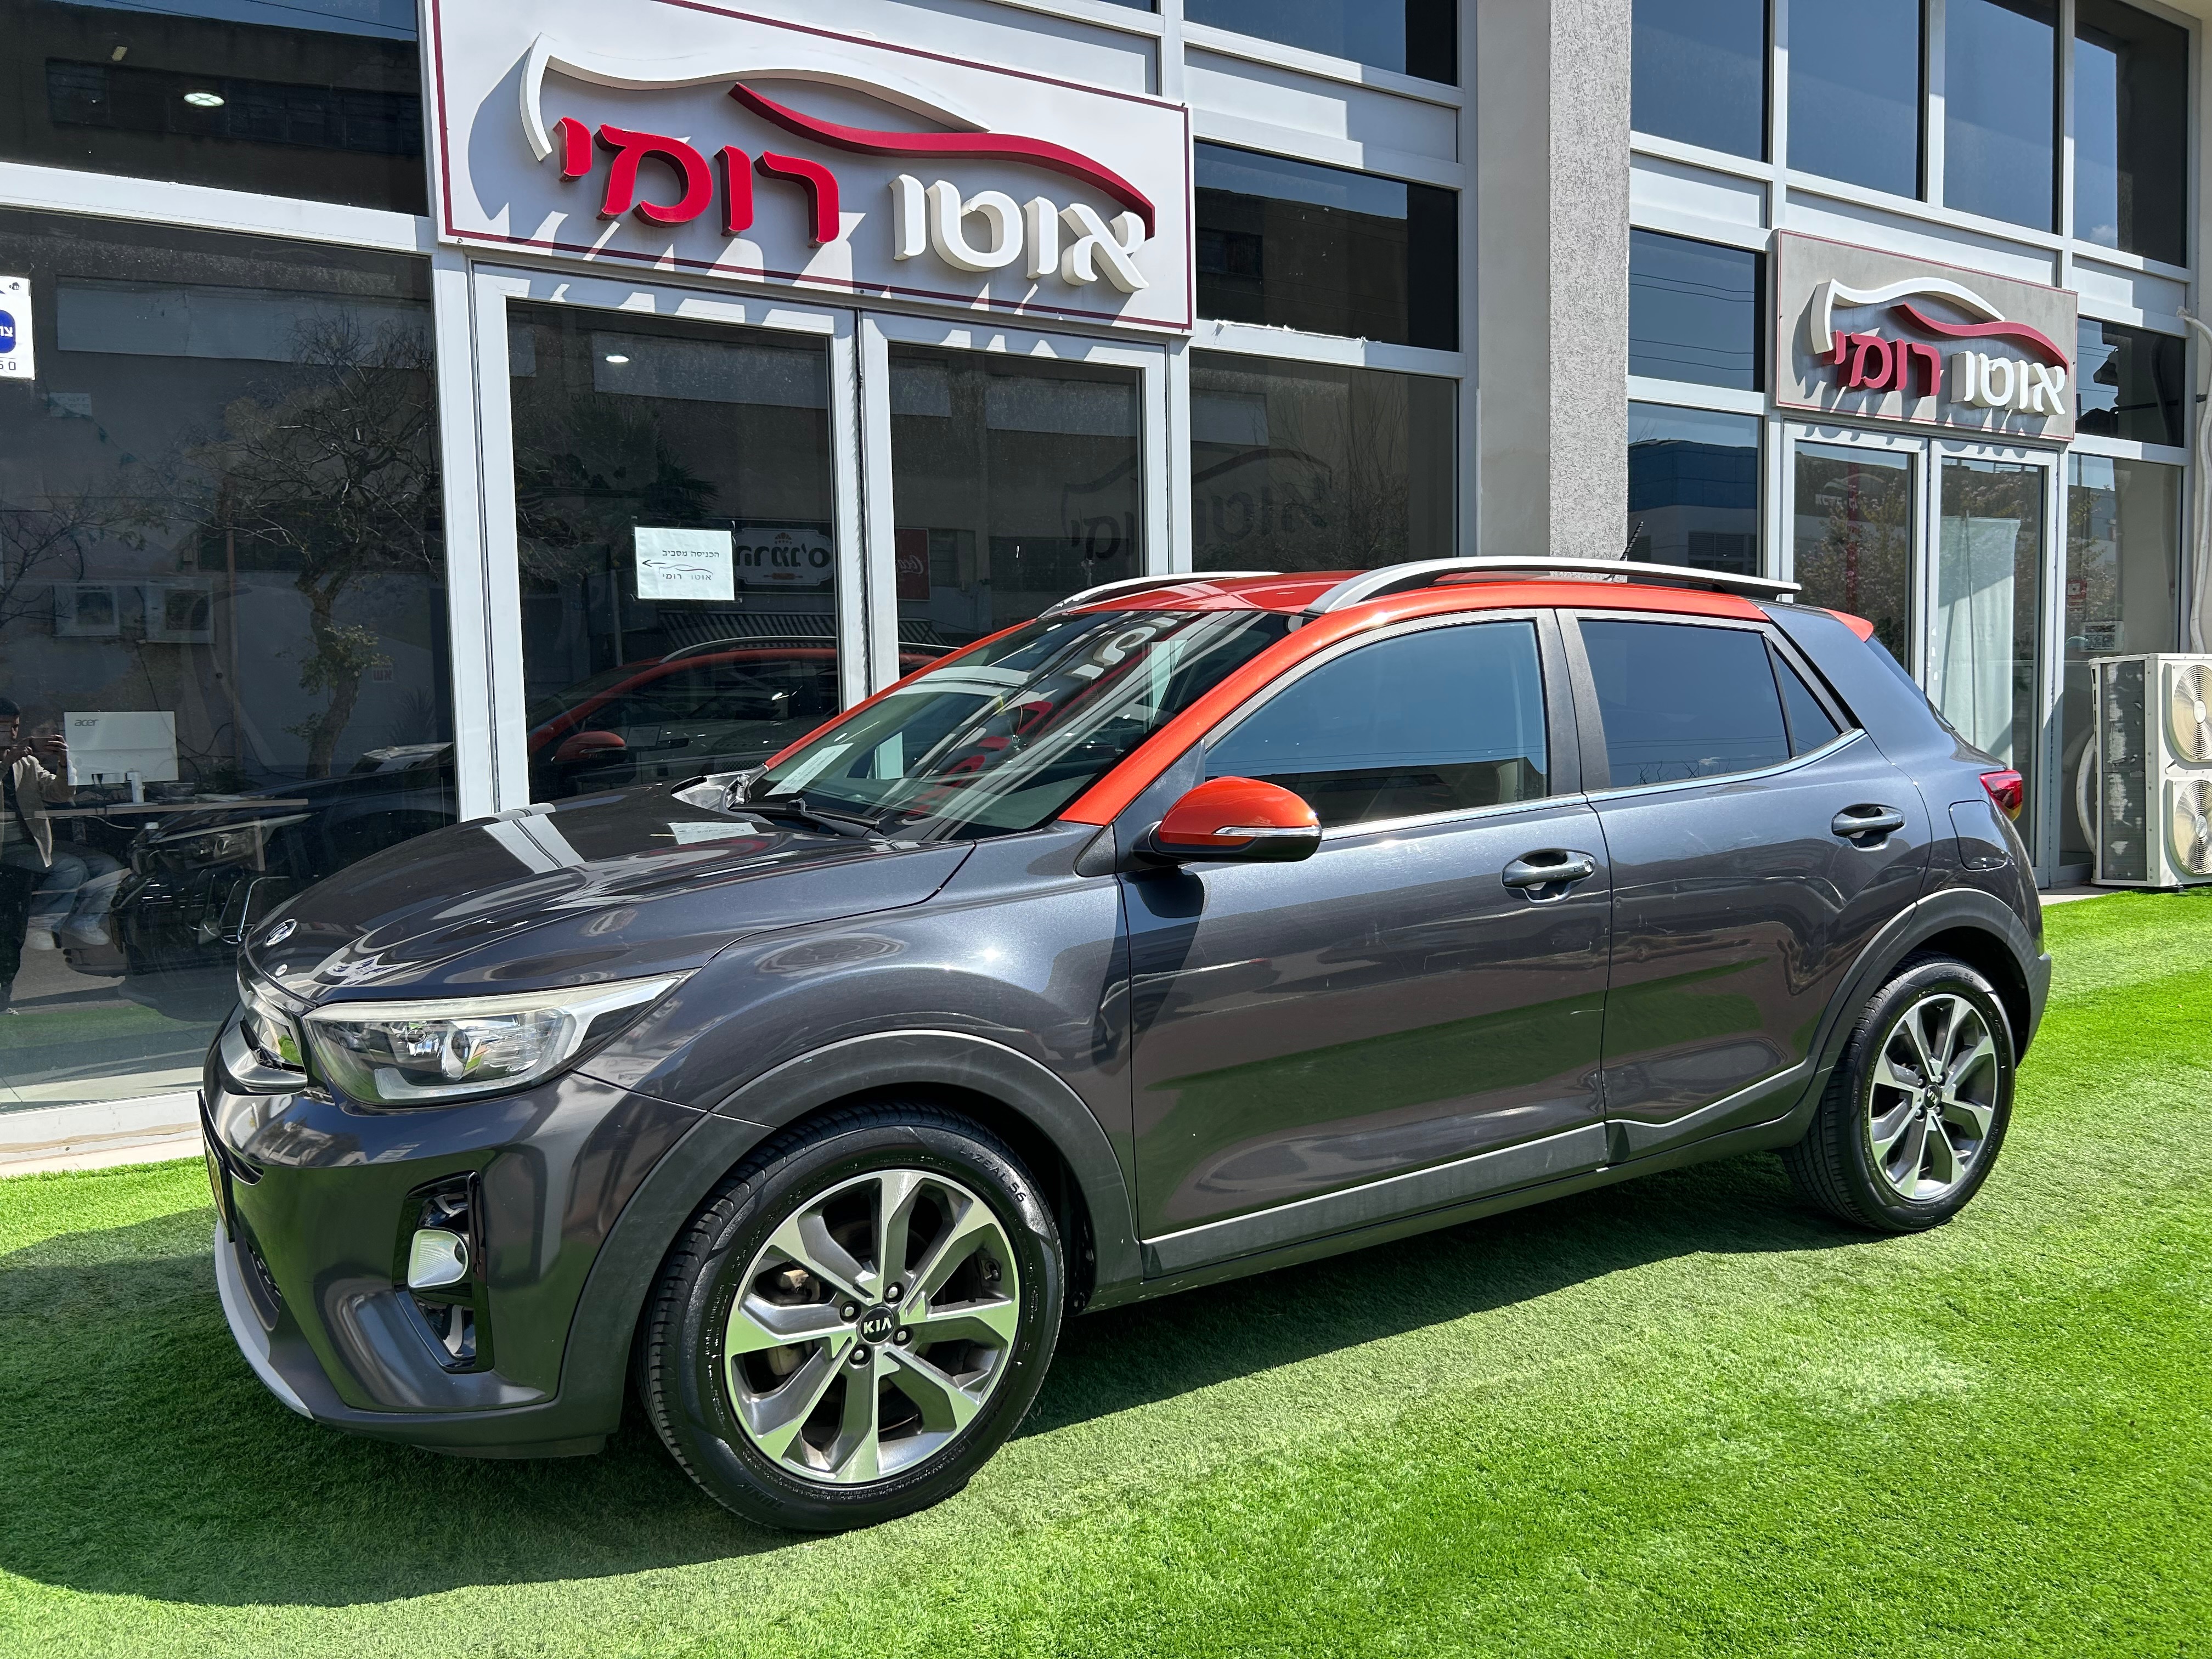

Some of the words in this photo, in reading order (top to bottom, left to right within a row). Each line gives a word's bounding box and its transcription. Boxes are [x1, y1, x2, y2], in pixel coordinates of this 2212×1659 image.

[554, 116, 840, 248] רומי
[890, 172, 1149, 293] אוטו
[1822, 330, 1941, 398] רומי
[1951, 350, 2066, 415] אוטו
[1071, 512, 1135, 560] ומי
[1008, 1182, 1026, 1203] 56
[864, 1317, 891, 1334] KIA
